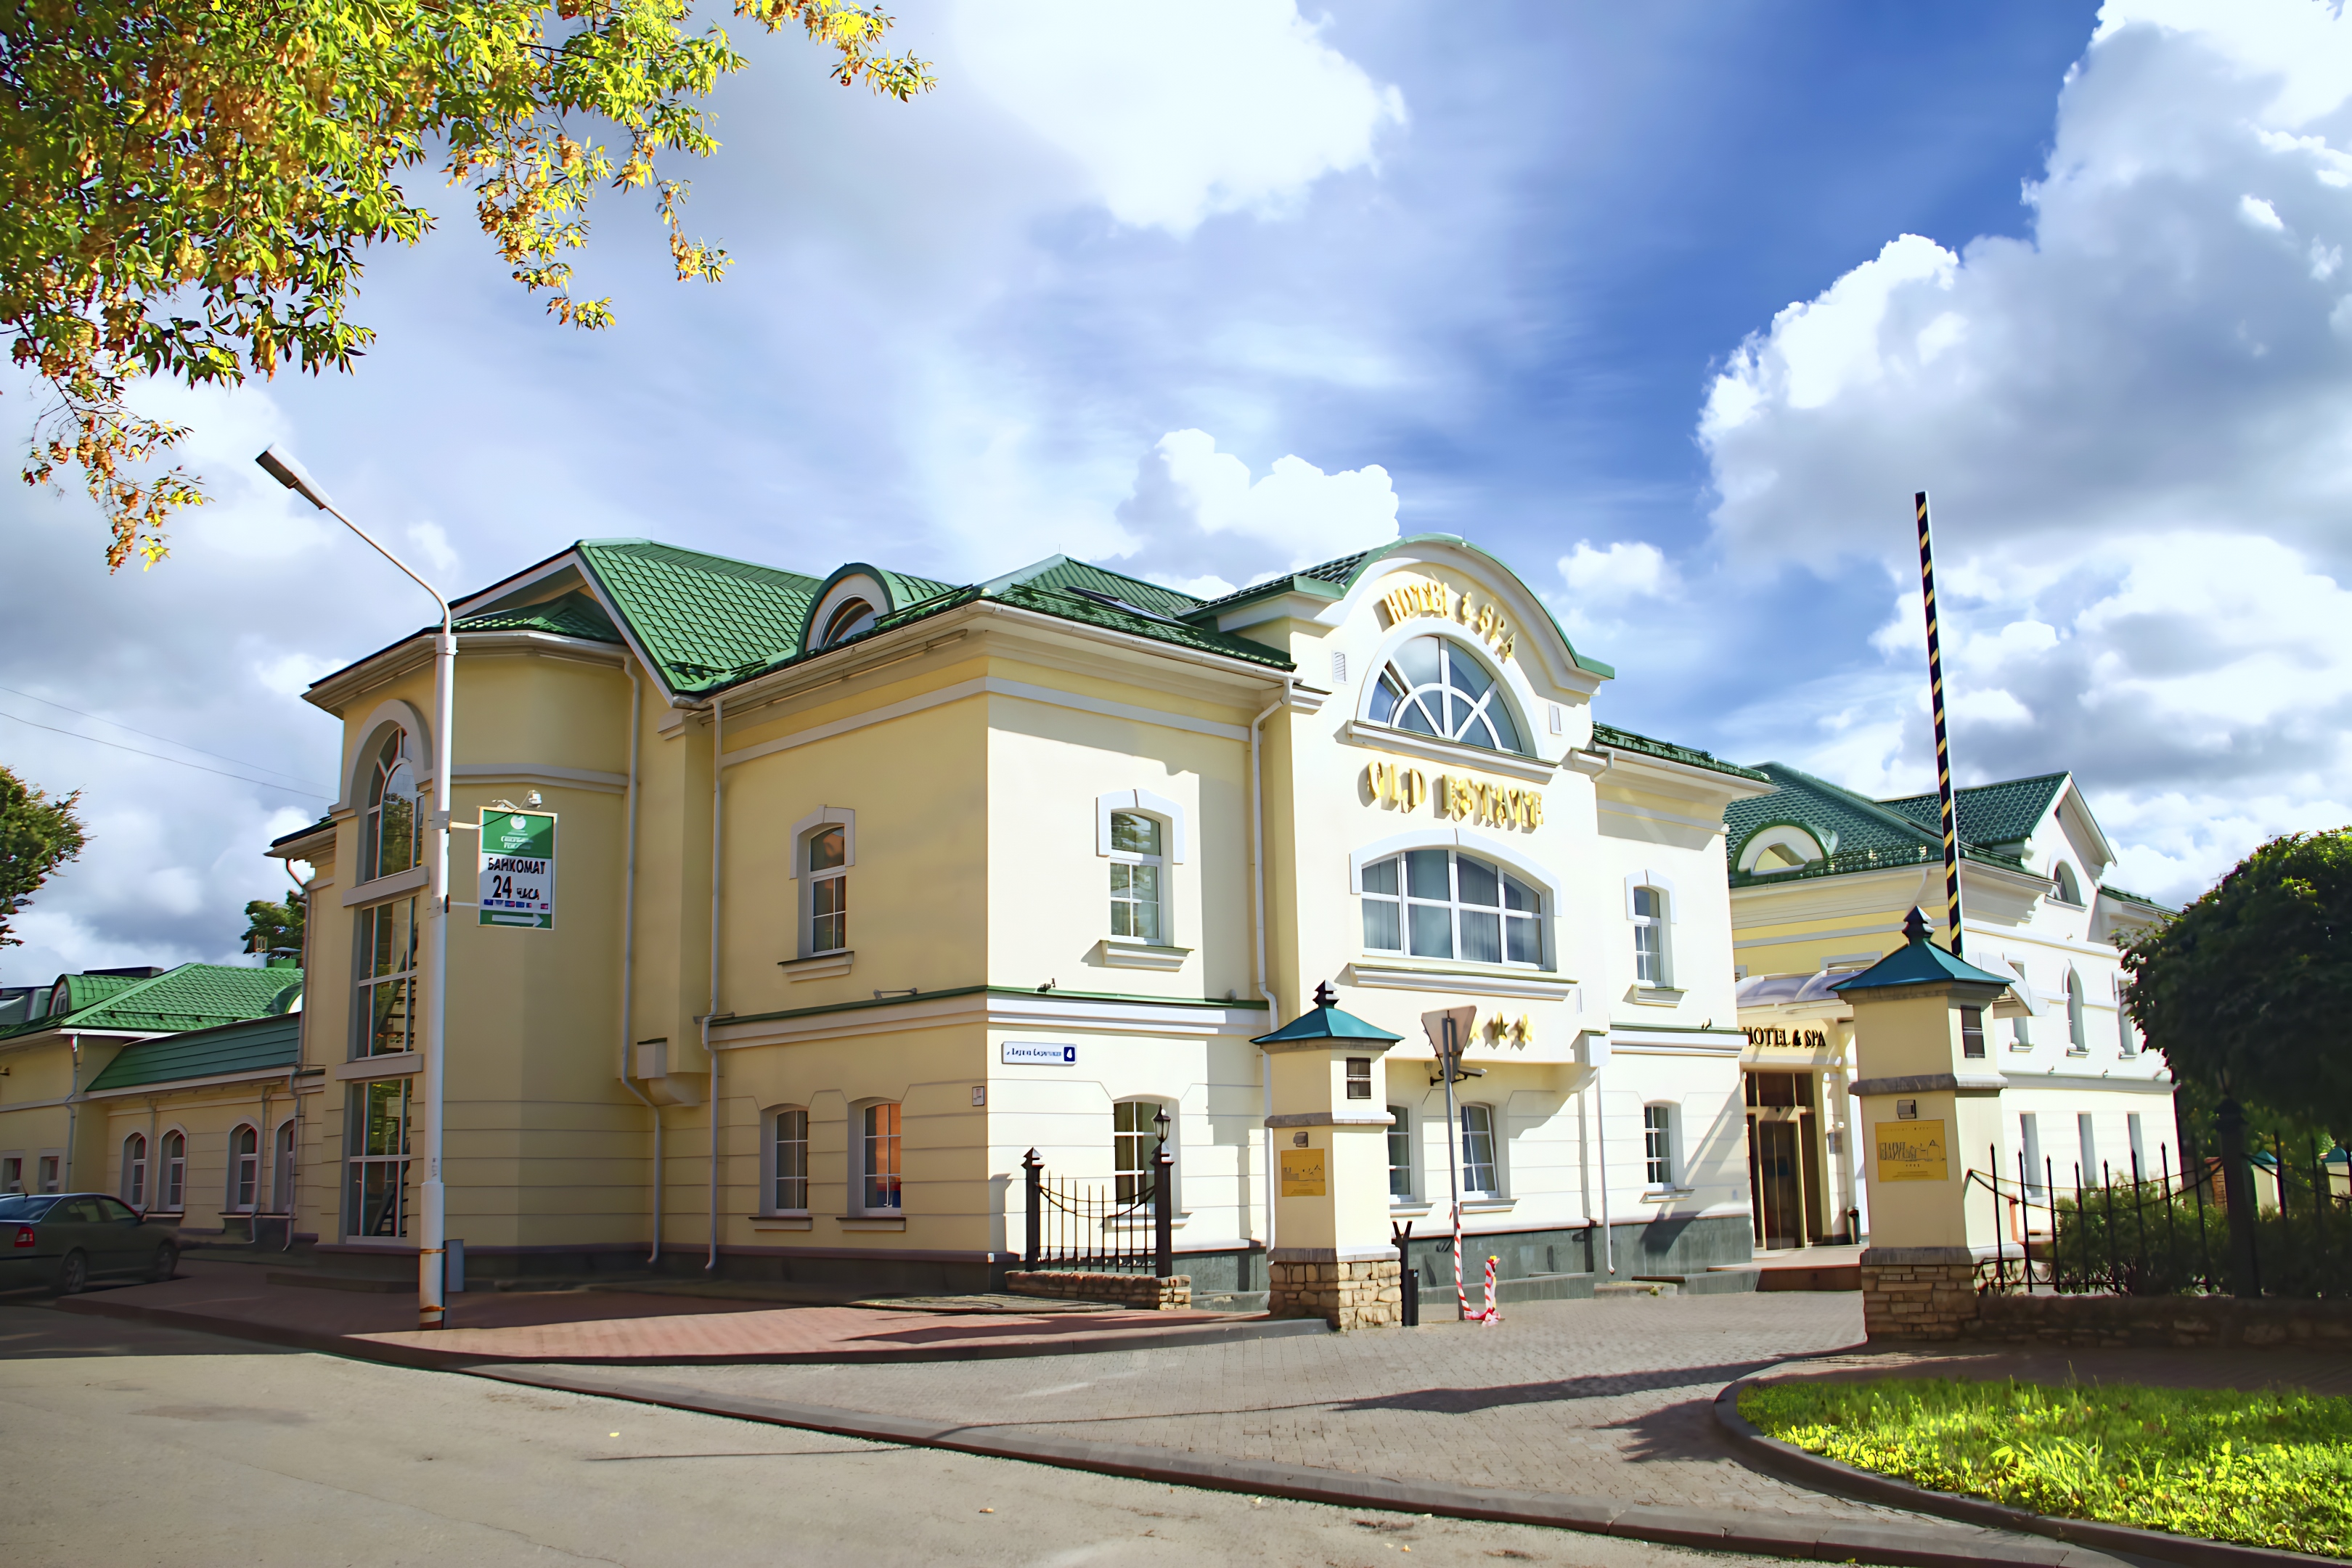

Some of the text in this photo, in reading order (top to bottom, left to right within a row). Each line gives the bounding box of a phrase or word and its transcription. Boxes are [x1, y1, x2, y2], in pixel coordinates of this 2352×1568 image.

[1384, 582, 1454, 625] HOTEL
[1478, 603, 1516, 658] SPA
[1368, 761, 1544, 829] OLD ESTATE
[487, 857, 546, 875] БАНКОМАТ
[492, 875, 513, 899] 24
[1792, 1029, 1802, 1047] &
[1803, 1029, 1826, 1048] SPA
